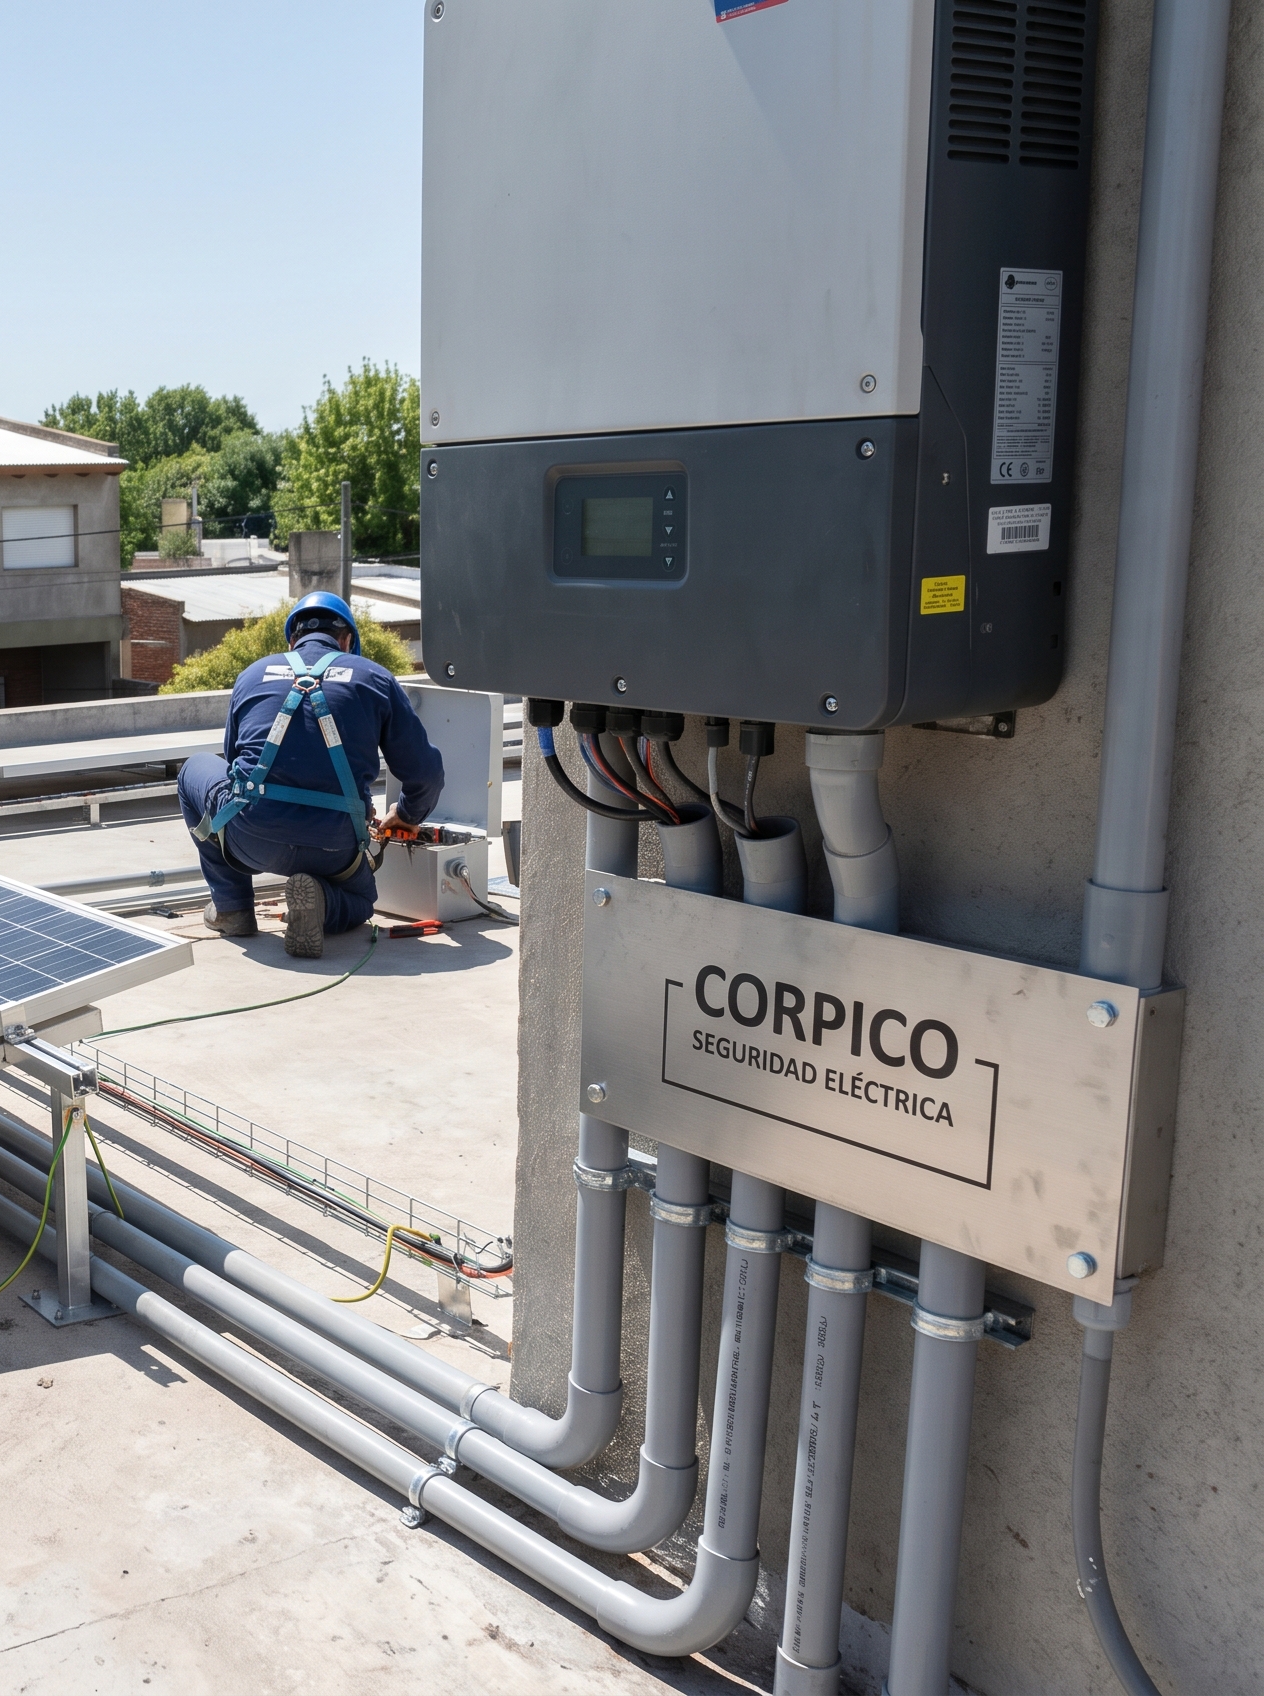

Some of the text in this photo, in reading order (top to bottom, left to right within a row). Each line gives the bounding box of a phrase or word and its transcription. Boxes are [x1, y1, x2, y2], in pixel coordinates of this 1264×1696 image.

[999, 462, 1013, 477] CE
[695, 965, 959, 1079] CORPICO
[692, 1029, 954, 1127] SEGURIDAD ELÉCTRICA
